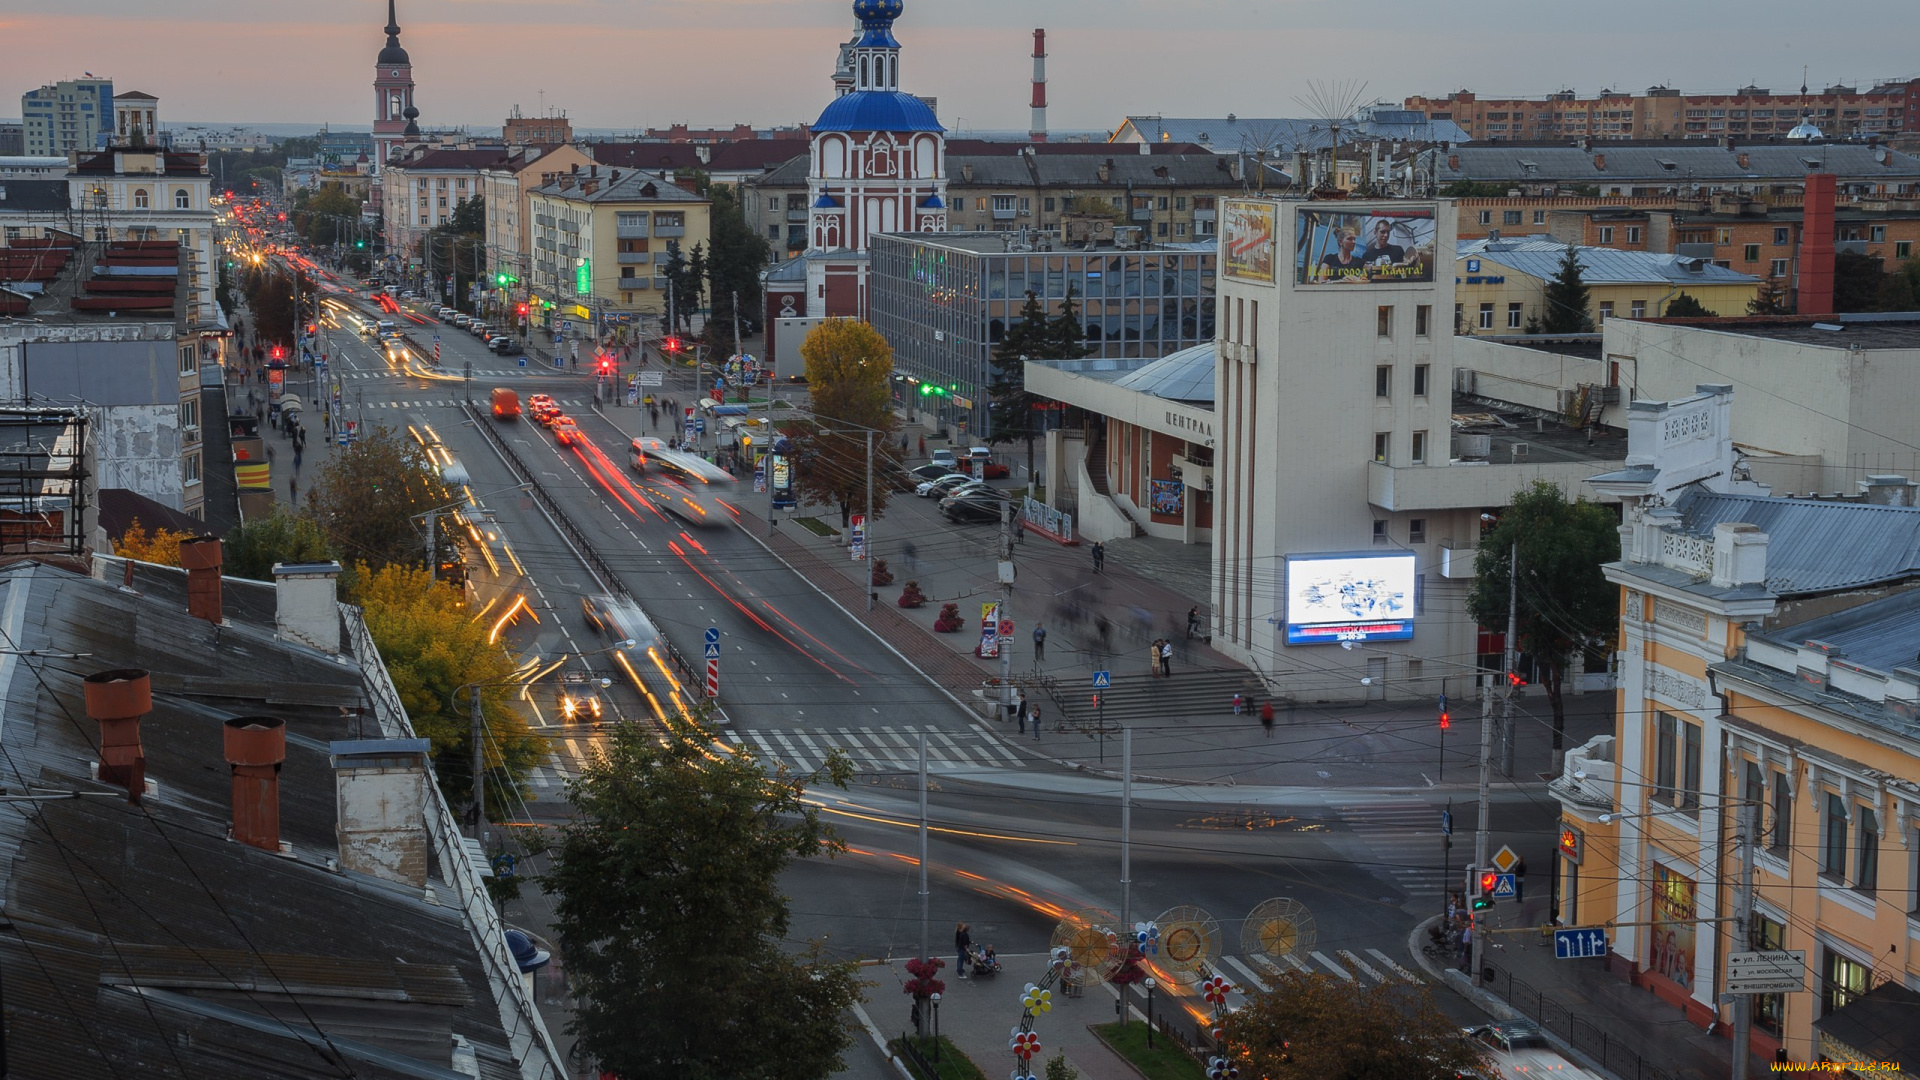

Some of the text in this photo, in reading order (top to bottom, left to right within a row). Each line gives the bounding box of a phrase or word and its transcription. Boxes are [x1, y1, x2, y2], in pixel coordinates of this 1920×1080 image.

[1308, 265, 1333, 276] Наш
[1338, 268, 1368, 277] город
[1382, 263, 1423, 276] Калуга!
[1743, 954, 1789, 964] ул. ЛЕНИНА
